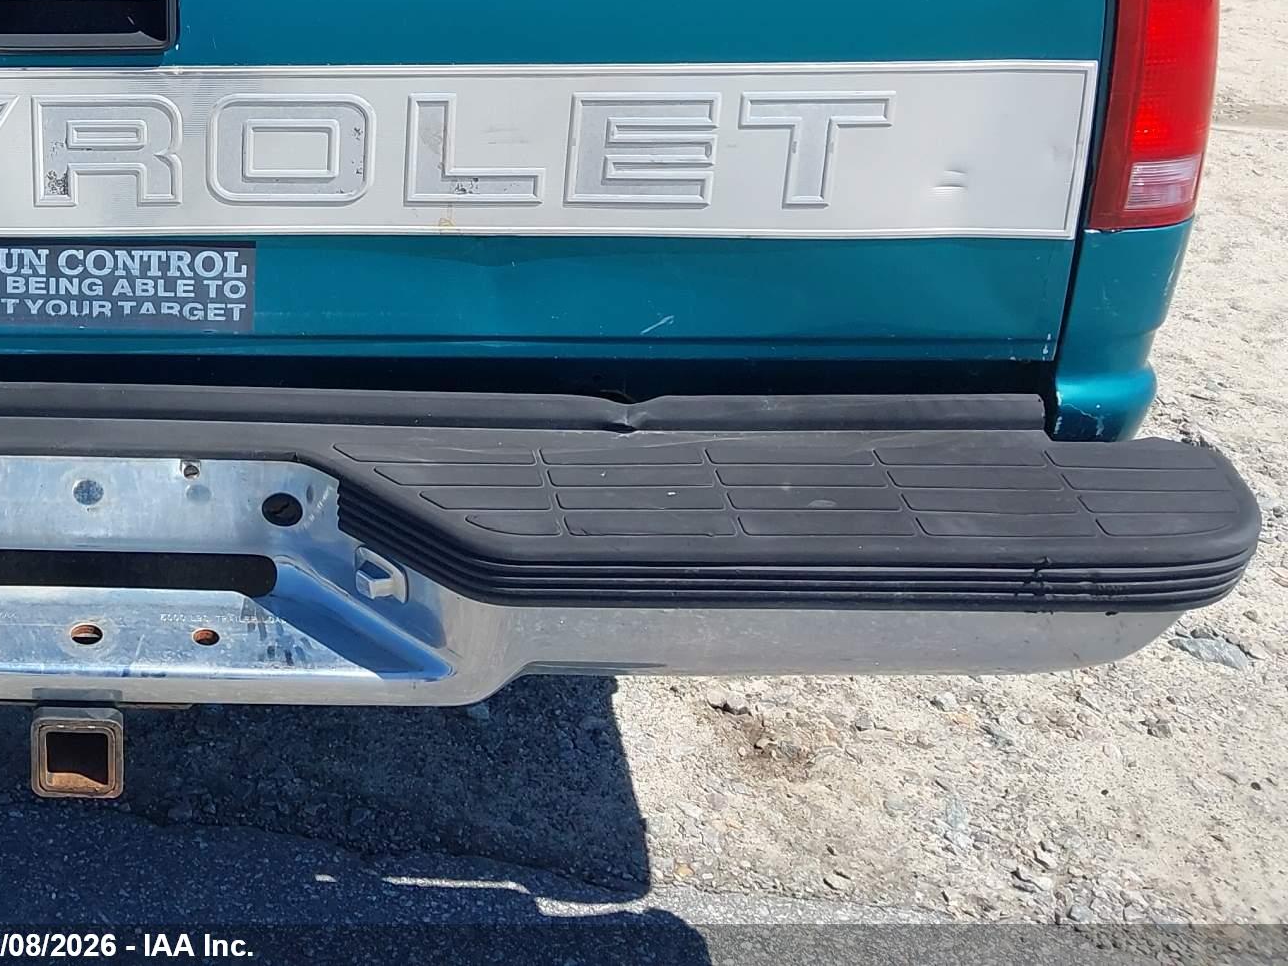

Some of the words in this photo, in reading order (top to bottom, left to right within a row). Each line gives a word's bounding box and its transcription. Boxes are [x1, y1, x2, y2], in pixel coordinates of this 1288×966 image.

[57, 248, 248, 279] CONTROL
[6, 275, 104, 296] BEING
[112, 277, 196, 298] ABLE
[200, 280, 247, 300] TO
[24, 299, 112, 318] YOUR
[118, 301, 247, 322] TARGET
